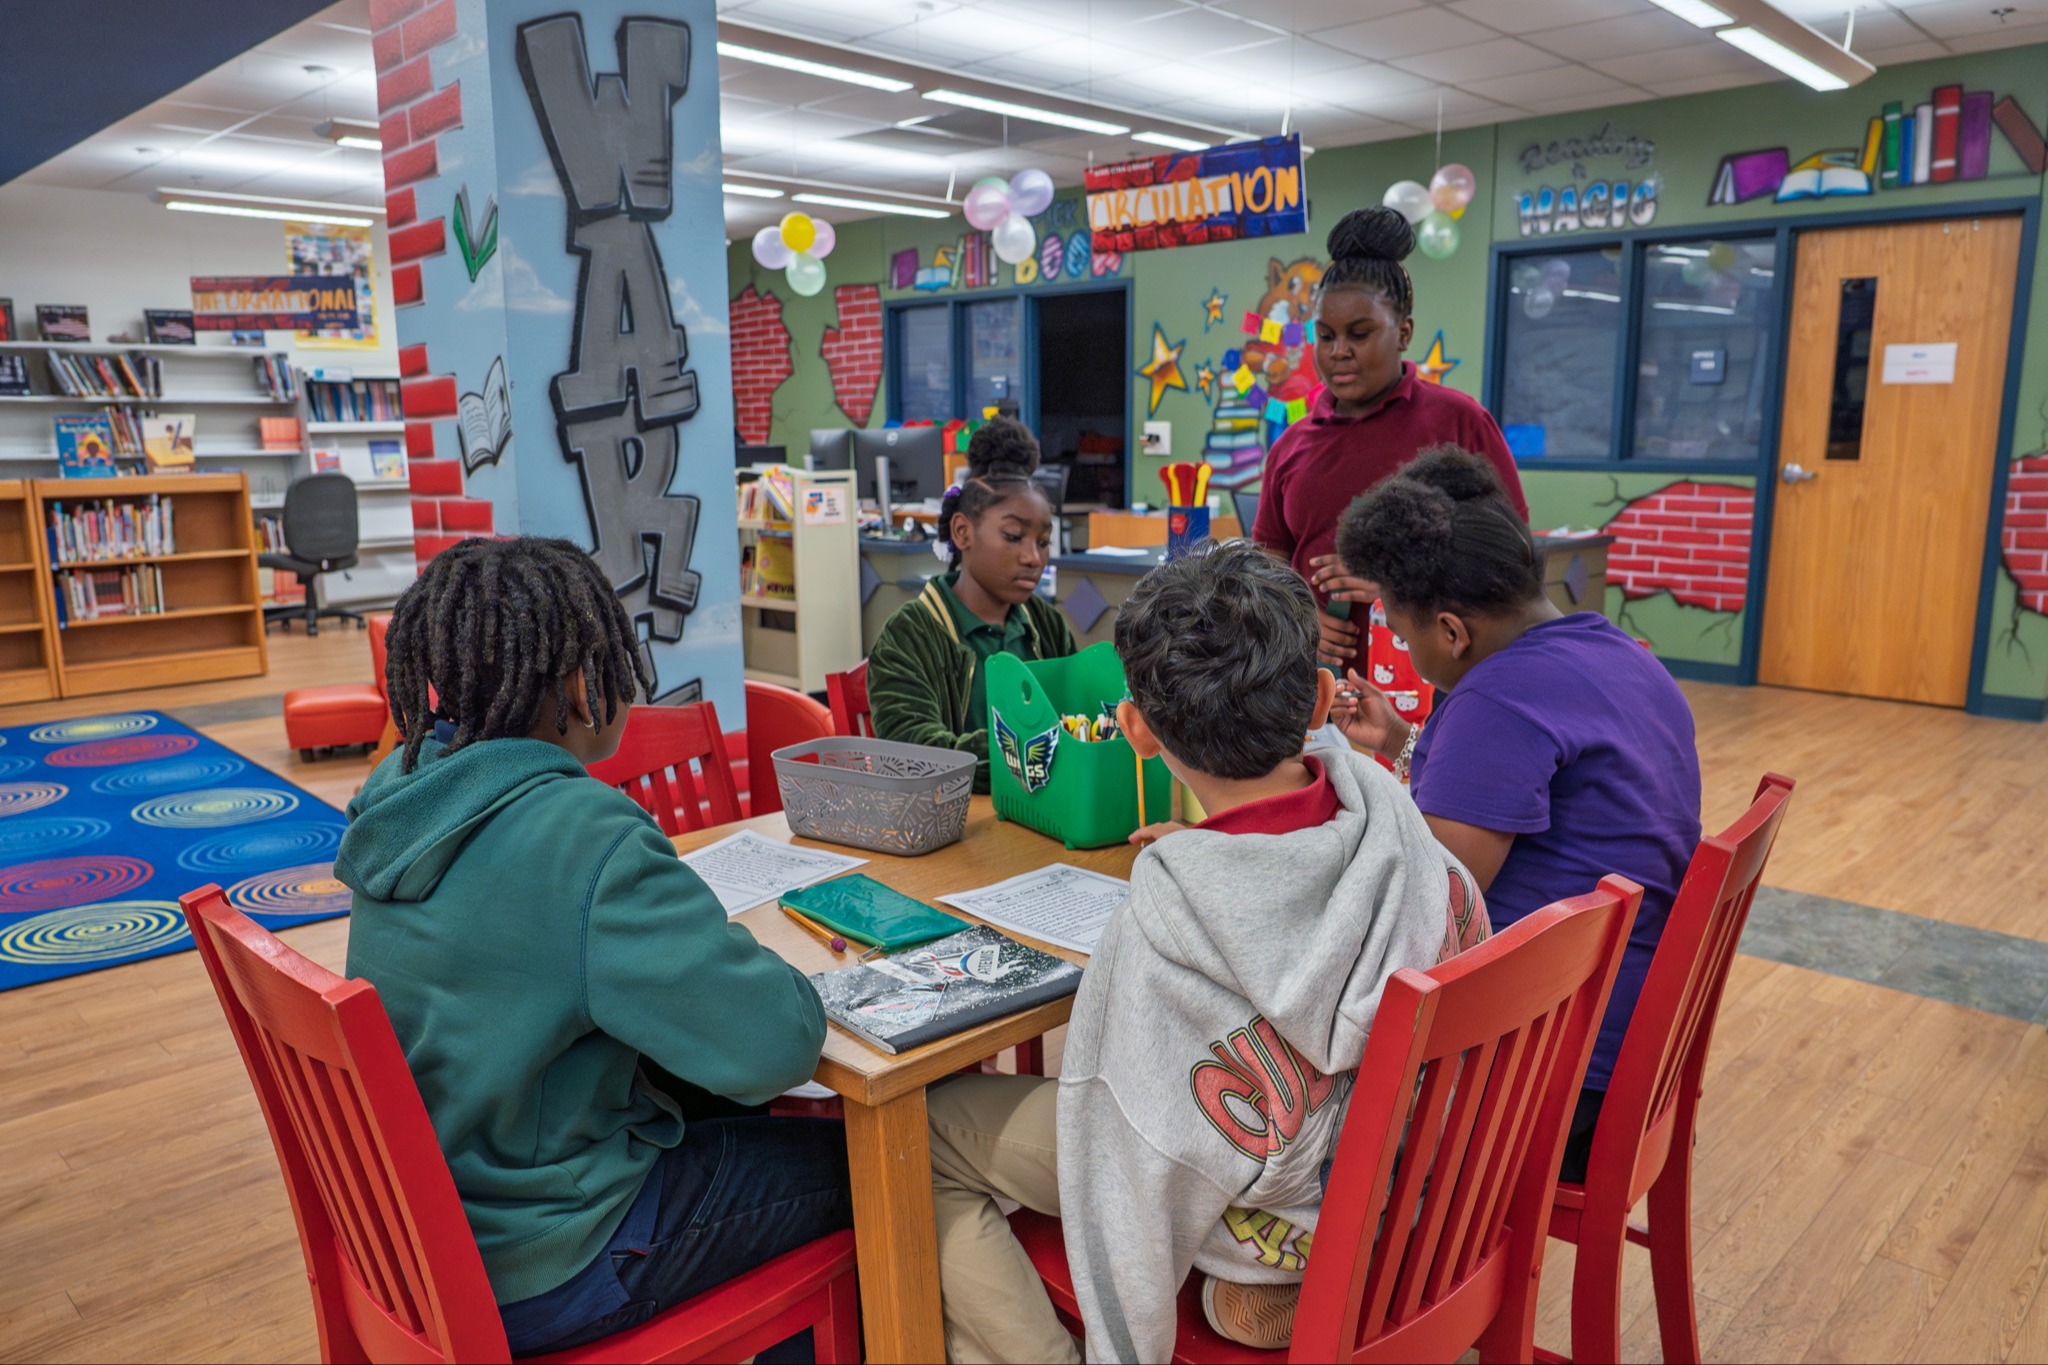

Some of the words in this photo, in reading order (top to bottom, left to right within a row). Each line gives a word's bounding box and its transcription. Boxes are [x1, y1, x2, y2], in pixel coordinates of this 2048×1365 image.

[1090, 165, 1300, 232] CIRCULATION
[1517, 179, 1658, 237] MAGIC
[192, 288, 356, 312] INFORMATIONAL
